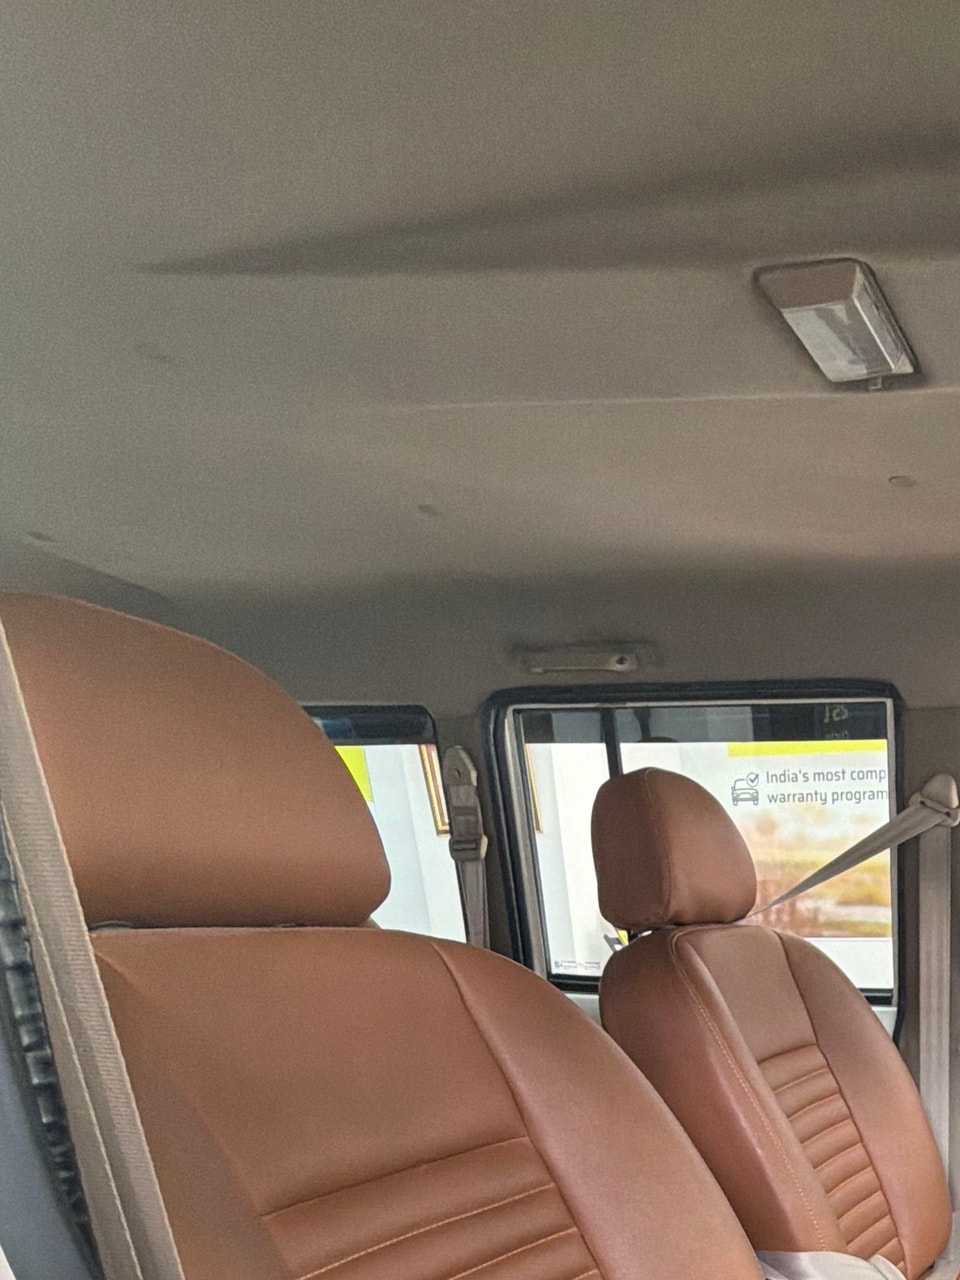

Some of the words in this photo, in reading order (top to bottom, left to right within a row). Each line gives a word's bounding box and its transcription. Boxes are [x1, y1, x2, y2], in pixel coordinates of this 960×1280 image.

[766, 770, 810, 784] India's
[813, 769, 847, 782] most
[767, 790, 828, 805] warranty
